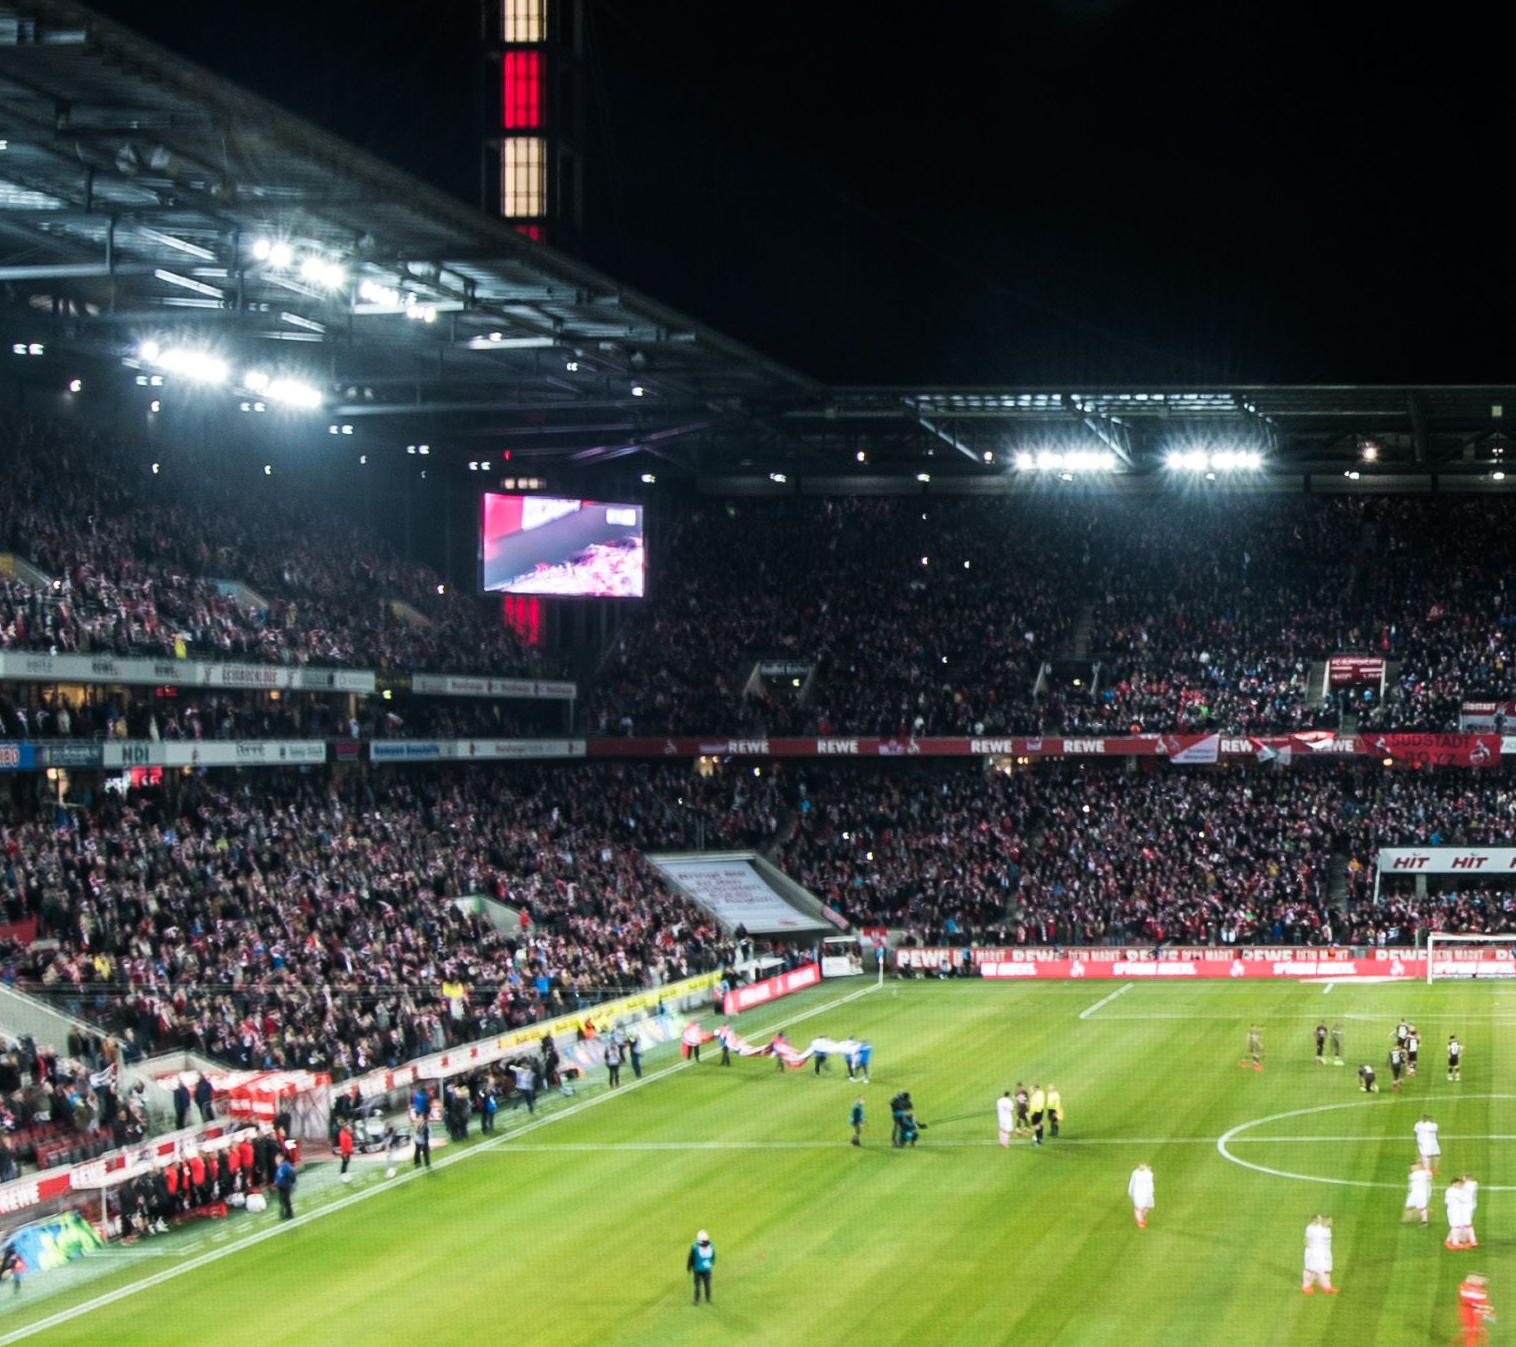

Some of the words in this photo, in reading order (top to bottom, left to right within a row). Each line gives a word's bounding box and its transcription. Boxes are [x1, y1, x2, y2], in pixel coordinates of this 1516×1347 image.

[729, 740, 770, 753] REWE
[817, 740, 858, 753] REWE
[971, 740, 1012, 753] REWE
[1063, 740, 1105, 753] REWE
[1221, 739, 1253, 753] REW
[1392, 856, 1430, 869] HIT
[1451, 856, 1488, 869] HIT
